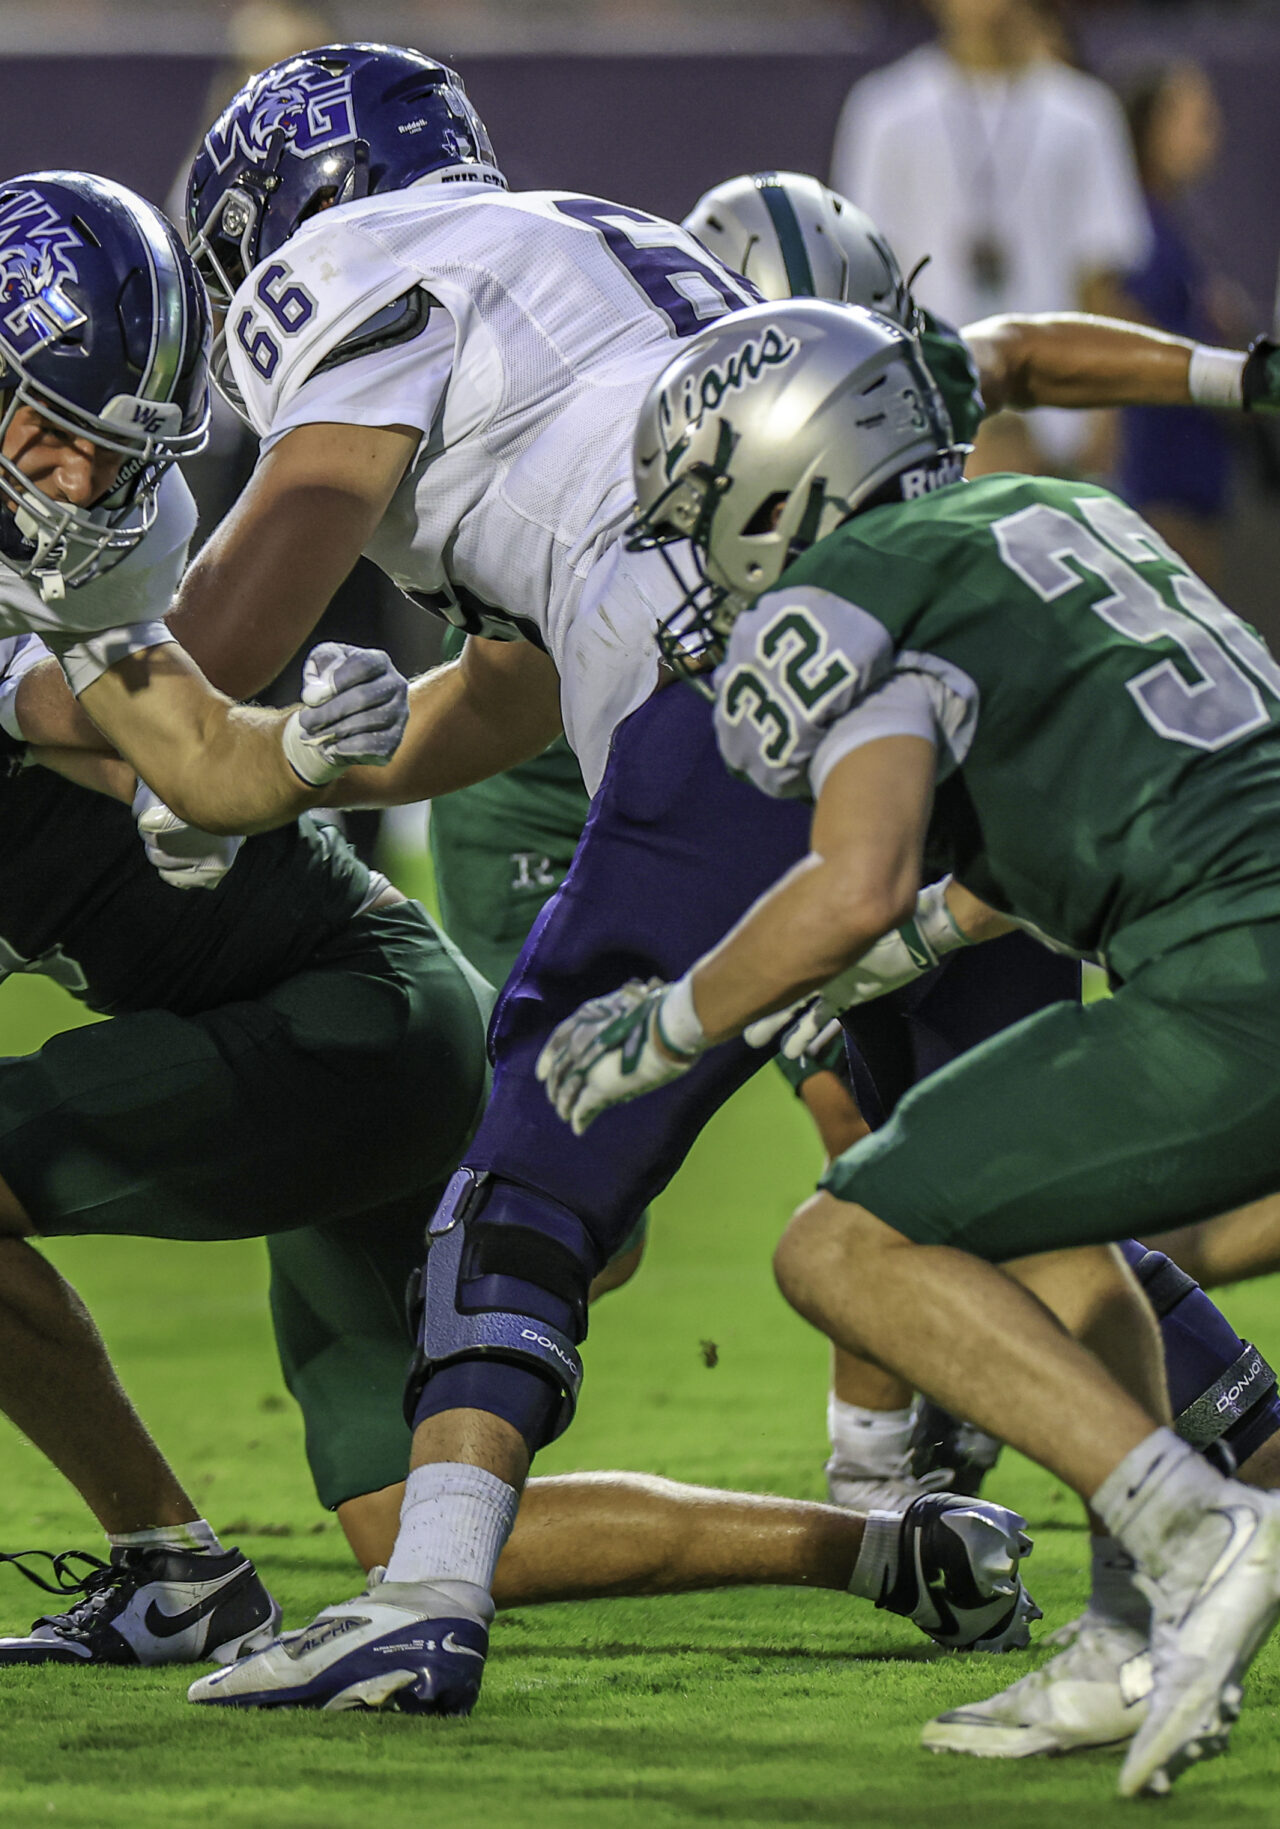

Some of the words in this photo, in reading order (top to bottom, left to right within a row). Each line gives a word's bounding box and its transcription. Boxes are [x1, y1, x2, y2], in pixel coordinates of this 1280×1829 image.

[233, 259, 320, 386] 66
[131, 404, 166, 434] WG
[659, 324, 801, 487] Lions
[722, 604, 859, 768] 32
[1216, 1353, 1264, 1412] DONJOY
[299, 1619, 360, 1656] ALPHA
